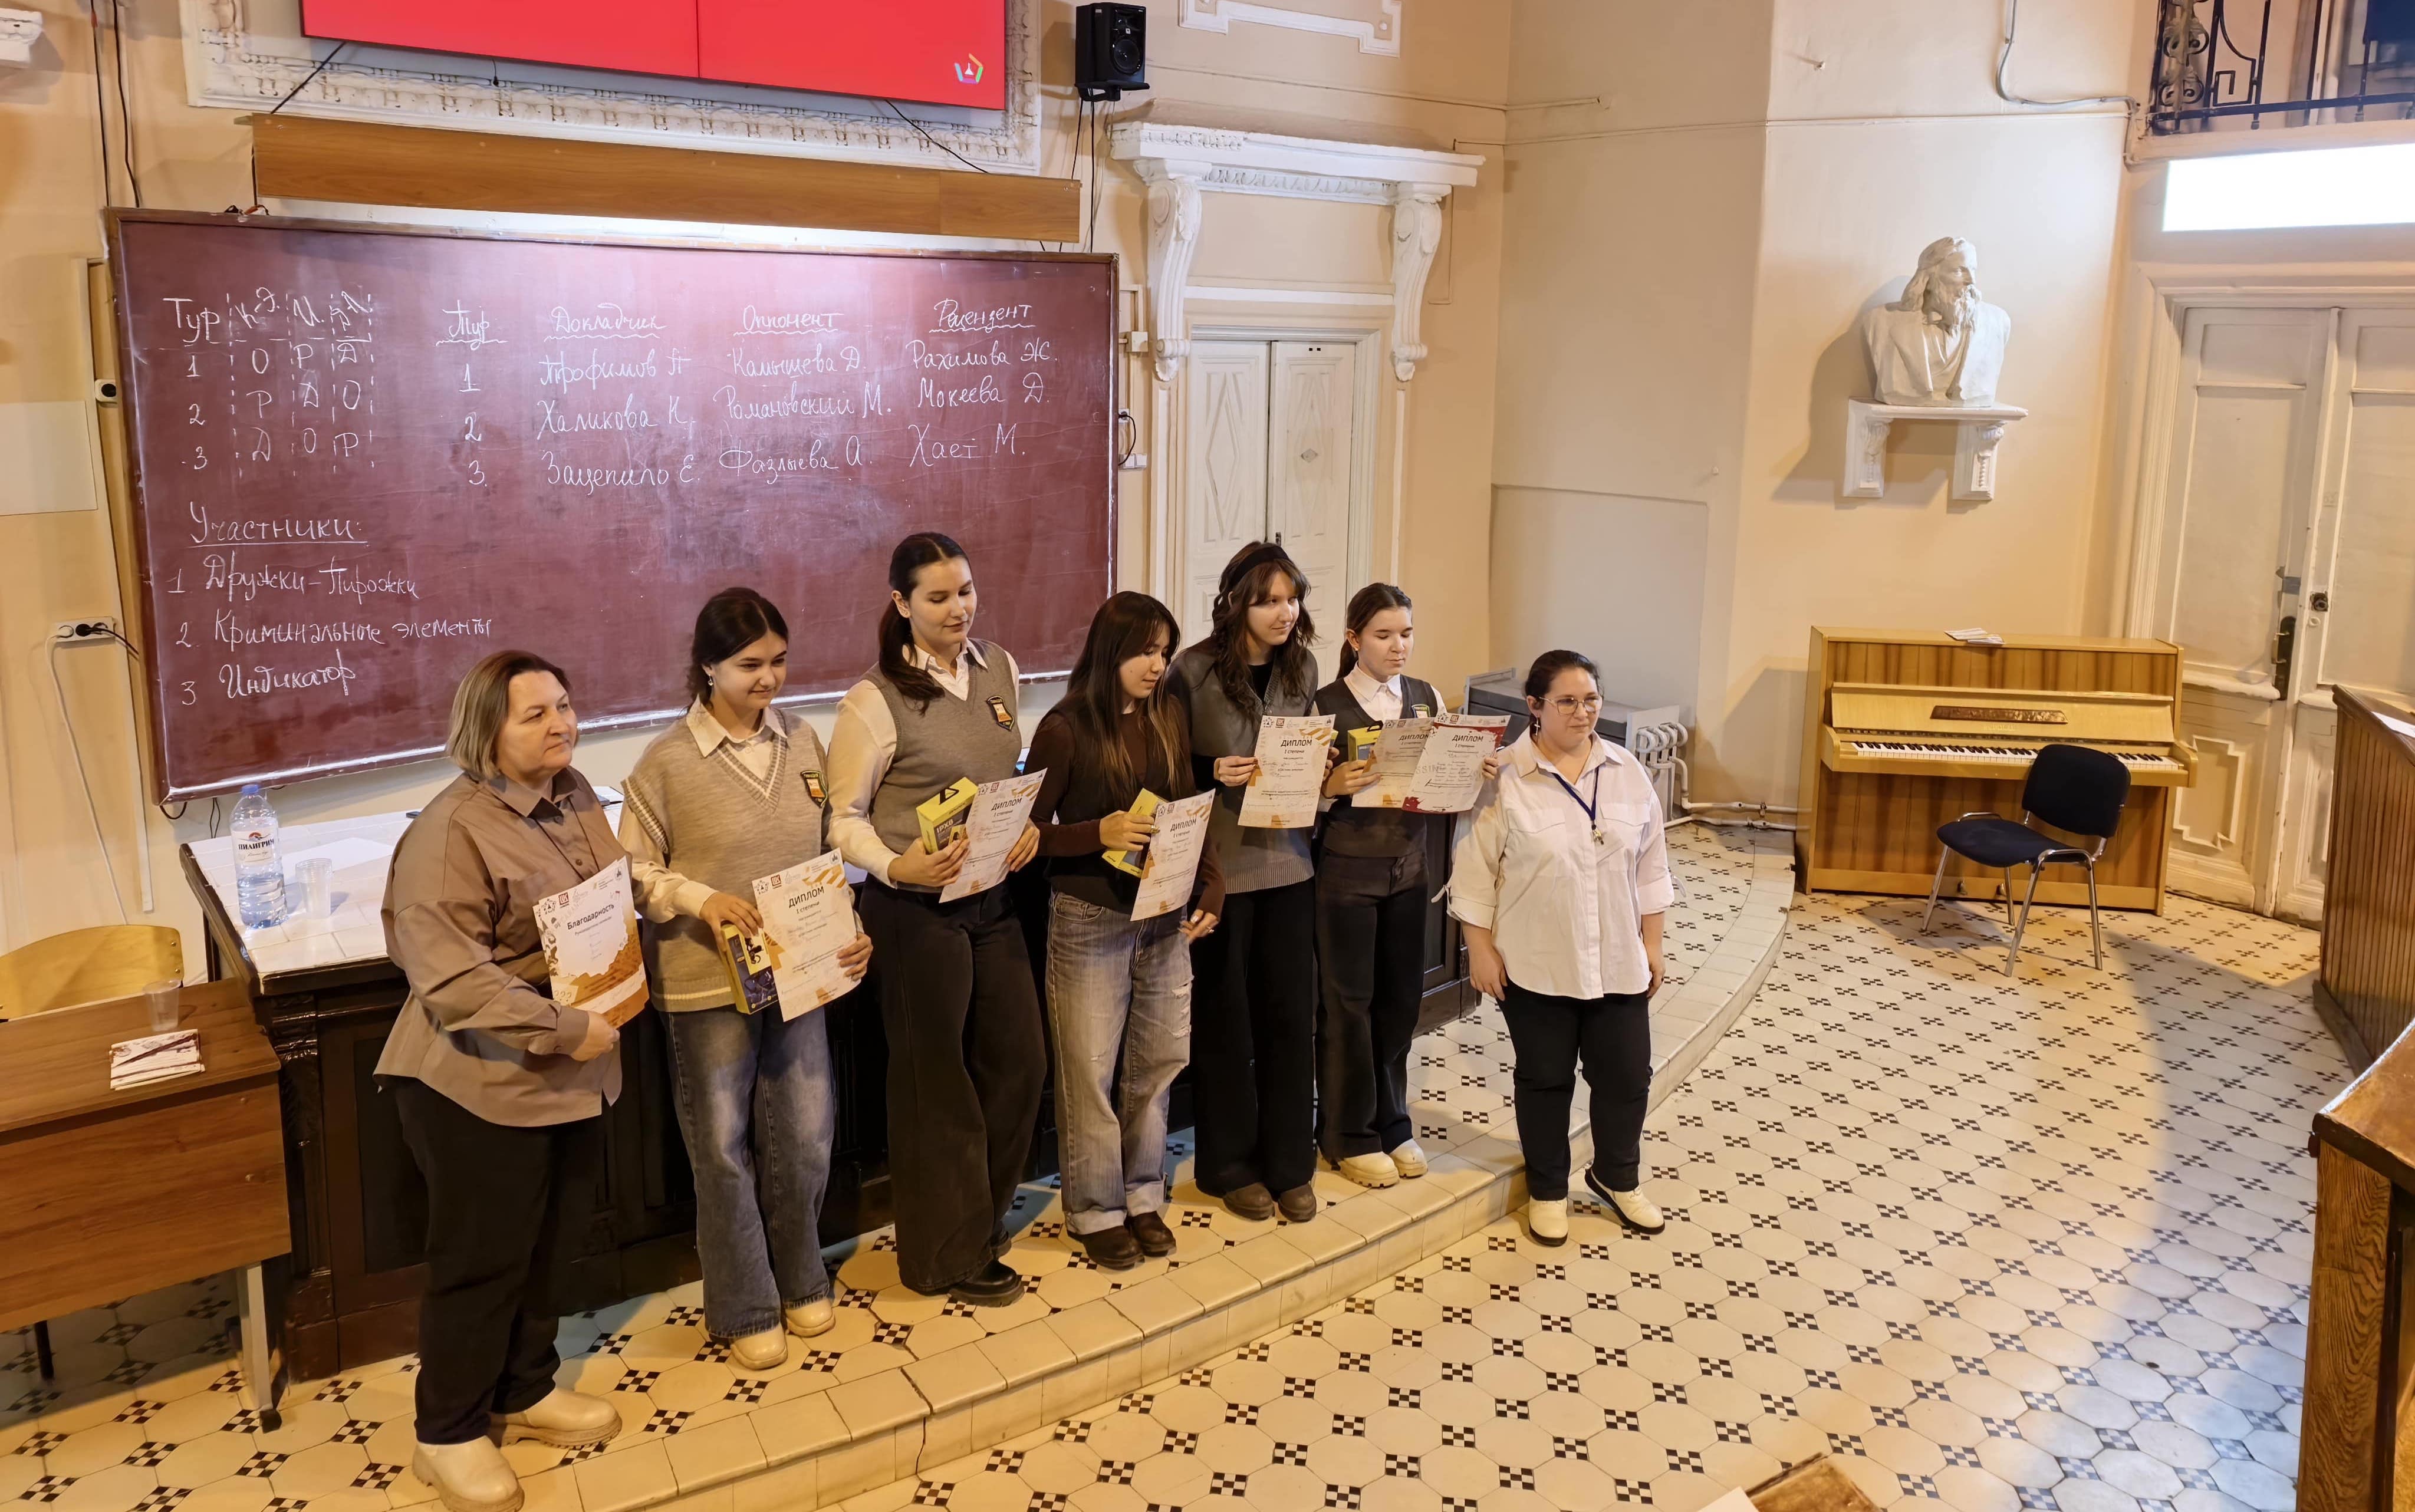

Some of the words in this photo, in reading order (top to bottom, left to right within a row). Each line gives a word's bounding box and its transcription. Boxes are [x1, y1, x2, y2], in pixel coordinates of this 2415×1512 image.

[163, 298, 221, 344] Тур
[442, 299, 490, 350] Тур
[551, 302, 667, 334] Докладчик
[742, 305, 844, 328] Оппонент
[933, 298, 1032, 333] Рецензент
[186, 355, 200, 377] 1
[294, 344, 314, 369] Р
[459, 363, 481, 391] 1
[538, 348, 656, 394] Трофимов
[906, 340, 1012, 370] Рахимова
[188, 403, 206, 425] 2
[246, 390, 272, 418] Р
[297, 382, 319, 408] Д
[465, 414, 482, 442] 2
[537, 393, 660, 440] Халикова
[917, 375, 1006, 408] Мокеева
[250, 427, 271, 462] Д
[335, 432, 358, 457] Р
[541, 451, 670, 496] Зацепило
[719, 439, 839, 485] Фазлыева
[907, 423, 978, 467] Хает
[995, 423, 1026, 456] М.
[166, 568, 185, 594] 1
[215, 608, 386, 653] Криминальные
[392, 617, 492, 638] элементы
[181, 681, 196, 705] 3
[219, 649, 356, 698] Индикатор
[991, 797, 1023, 812] ДИПЛОМ
[1170, 818, 1197, 832] ДИПЛОМ
[567, 904, 615, 930] Благодарность
[788, 886, 825, 908] ДИПЛОМ
